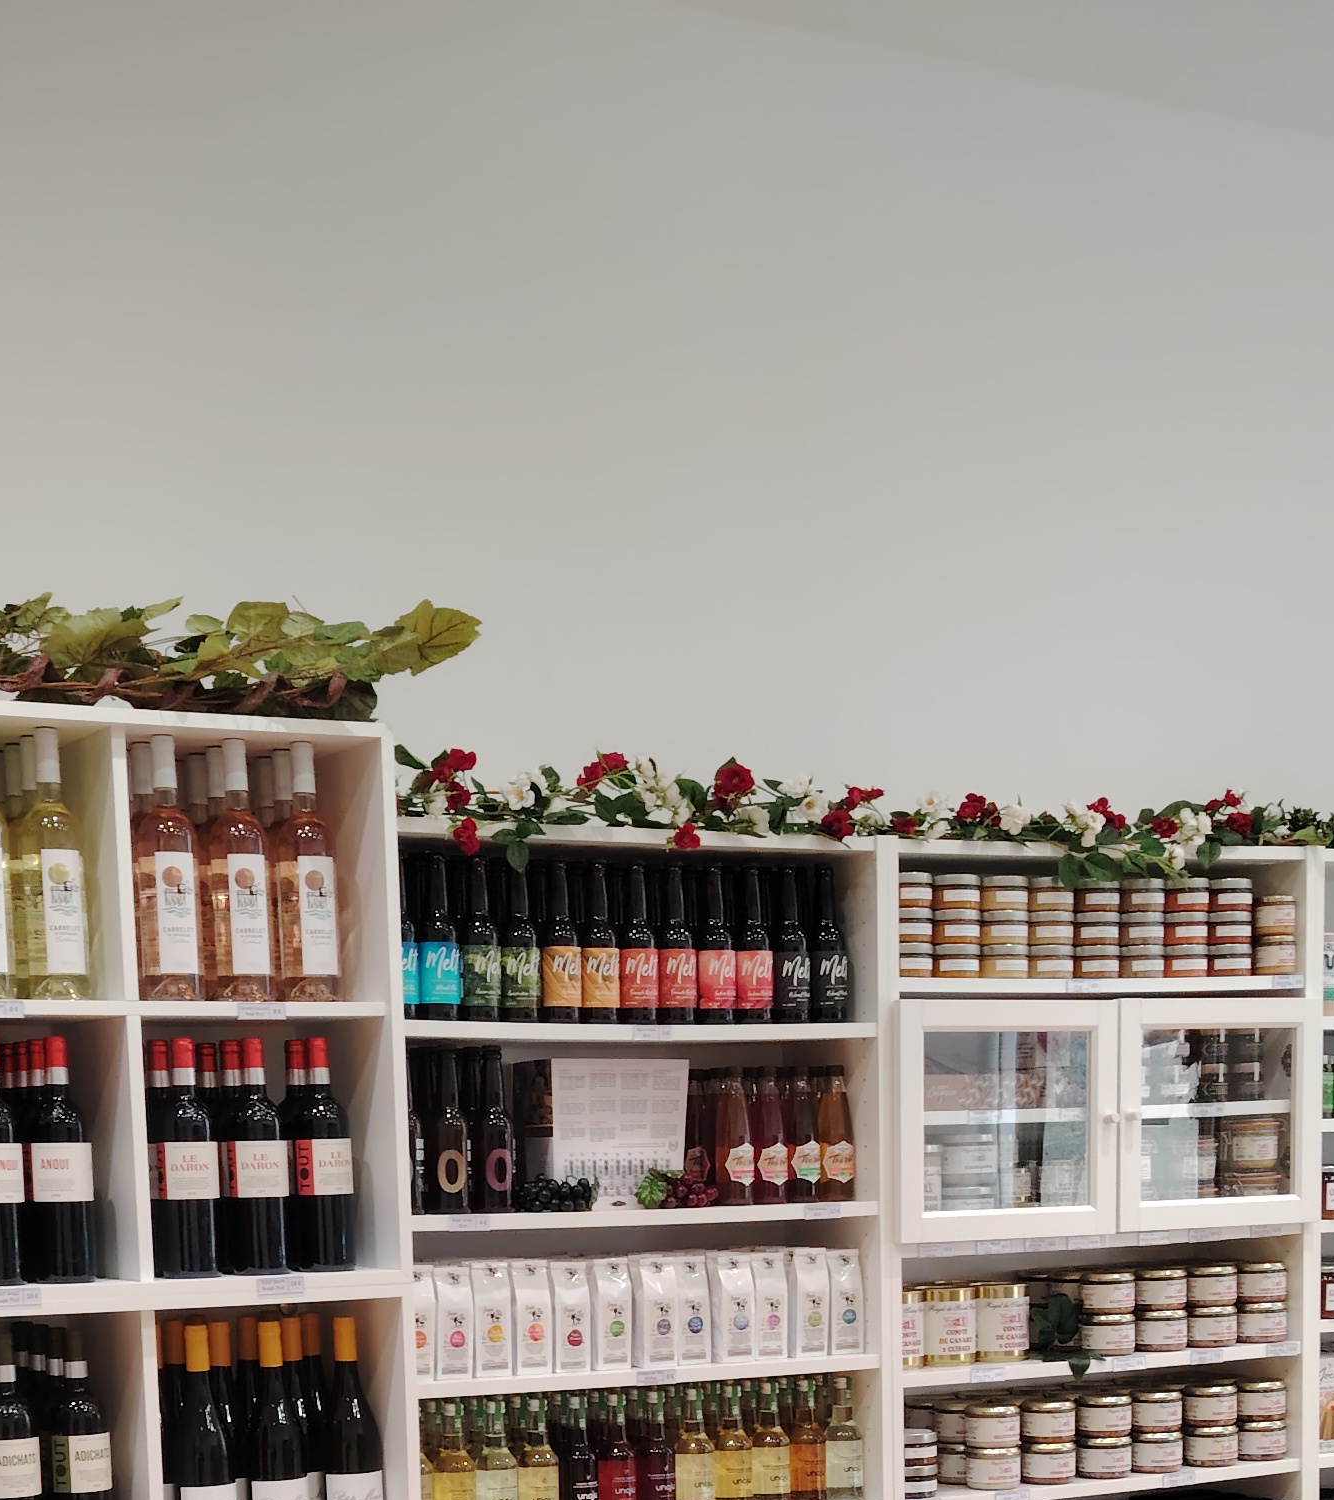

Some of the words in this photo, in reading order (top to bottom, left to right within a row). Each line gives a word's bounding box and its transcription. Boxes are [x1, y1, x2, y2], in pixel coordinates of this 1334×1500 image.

[426, 947, 460, 979] Melt
[625, 954, 658, 984] Melt
[666, 953, 697, 984] Melt
[742, 955, 772, 985] Melt
[820, 955, 848, 985] Melt
[182, 1153, 198, 1163] LE
[252, 1153, 268, 1162] LE
[330, 1150, 344, 1159] LE
[40, 1158, 69, 1170] ANQUI
[170, 1162, 211, 1173] DARON
[241, 1161, 280, 1171] DARON
[299, 1144, 311, 1192] TOUT
[318, 1157, 352, 1169] DARON
[74, 1447, 110, 1463] ADICHATS
[53, 1442, 68, 1488] TOUT
